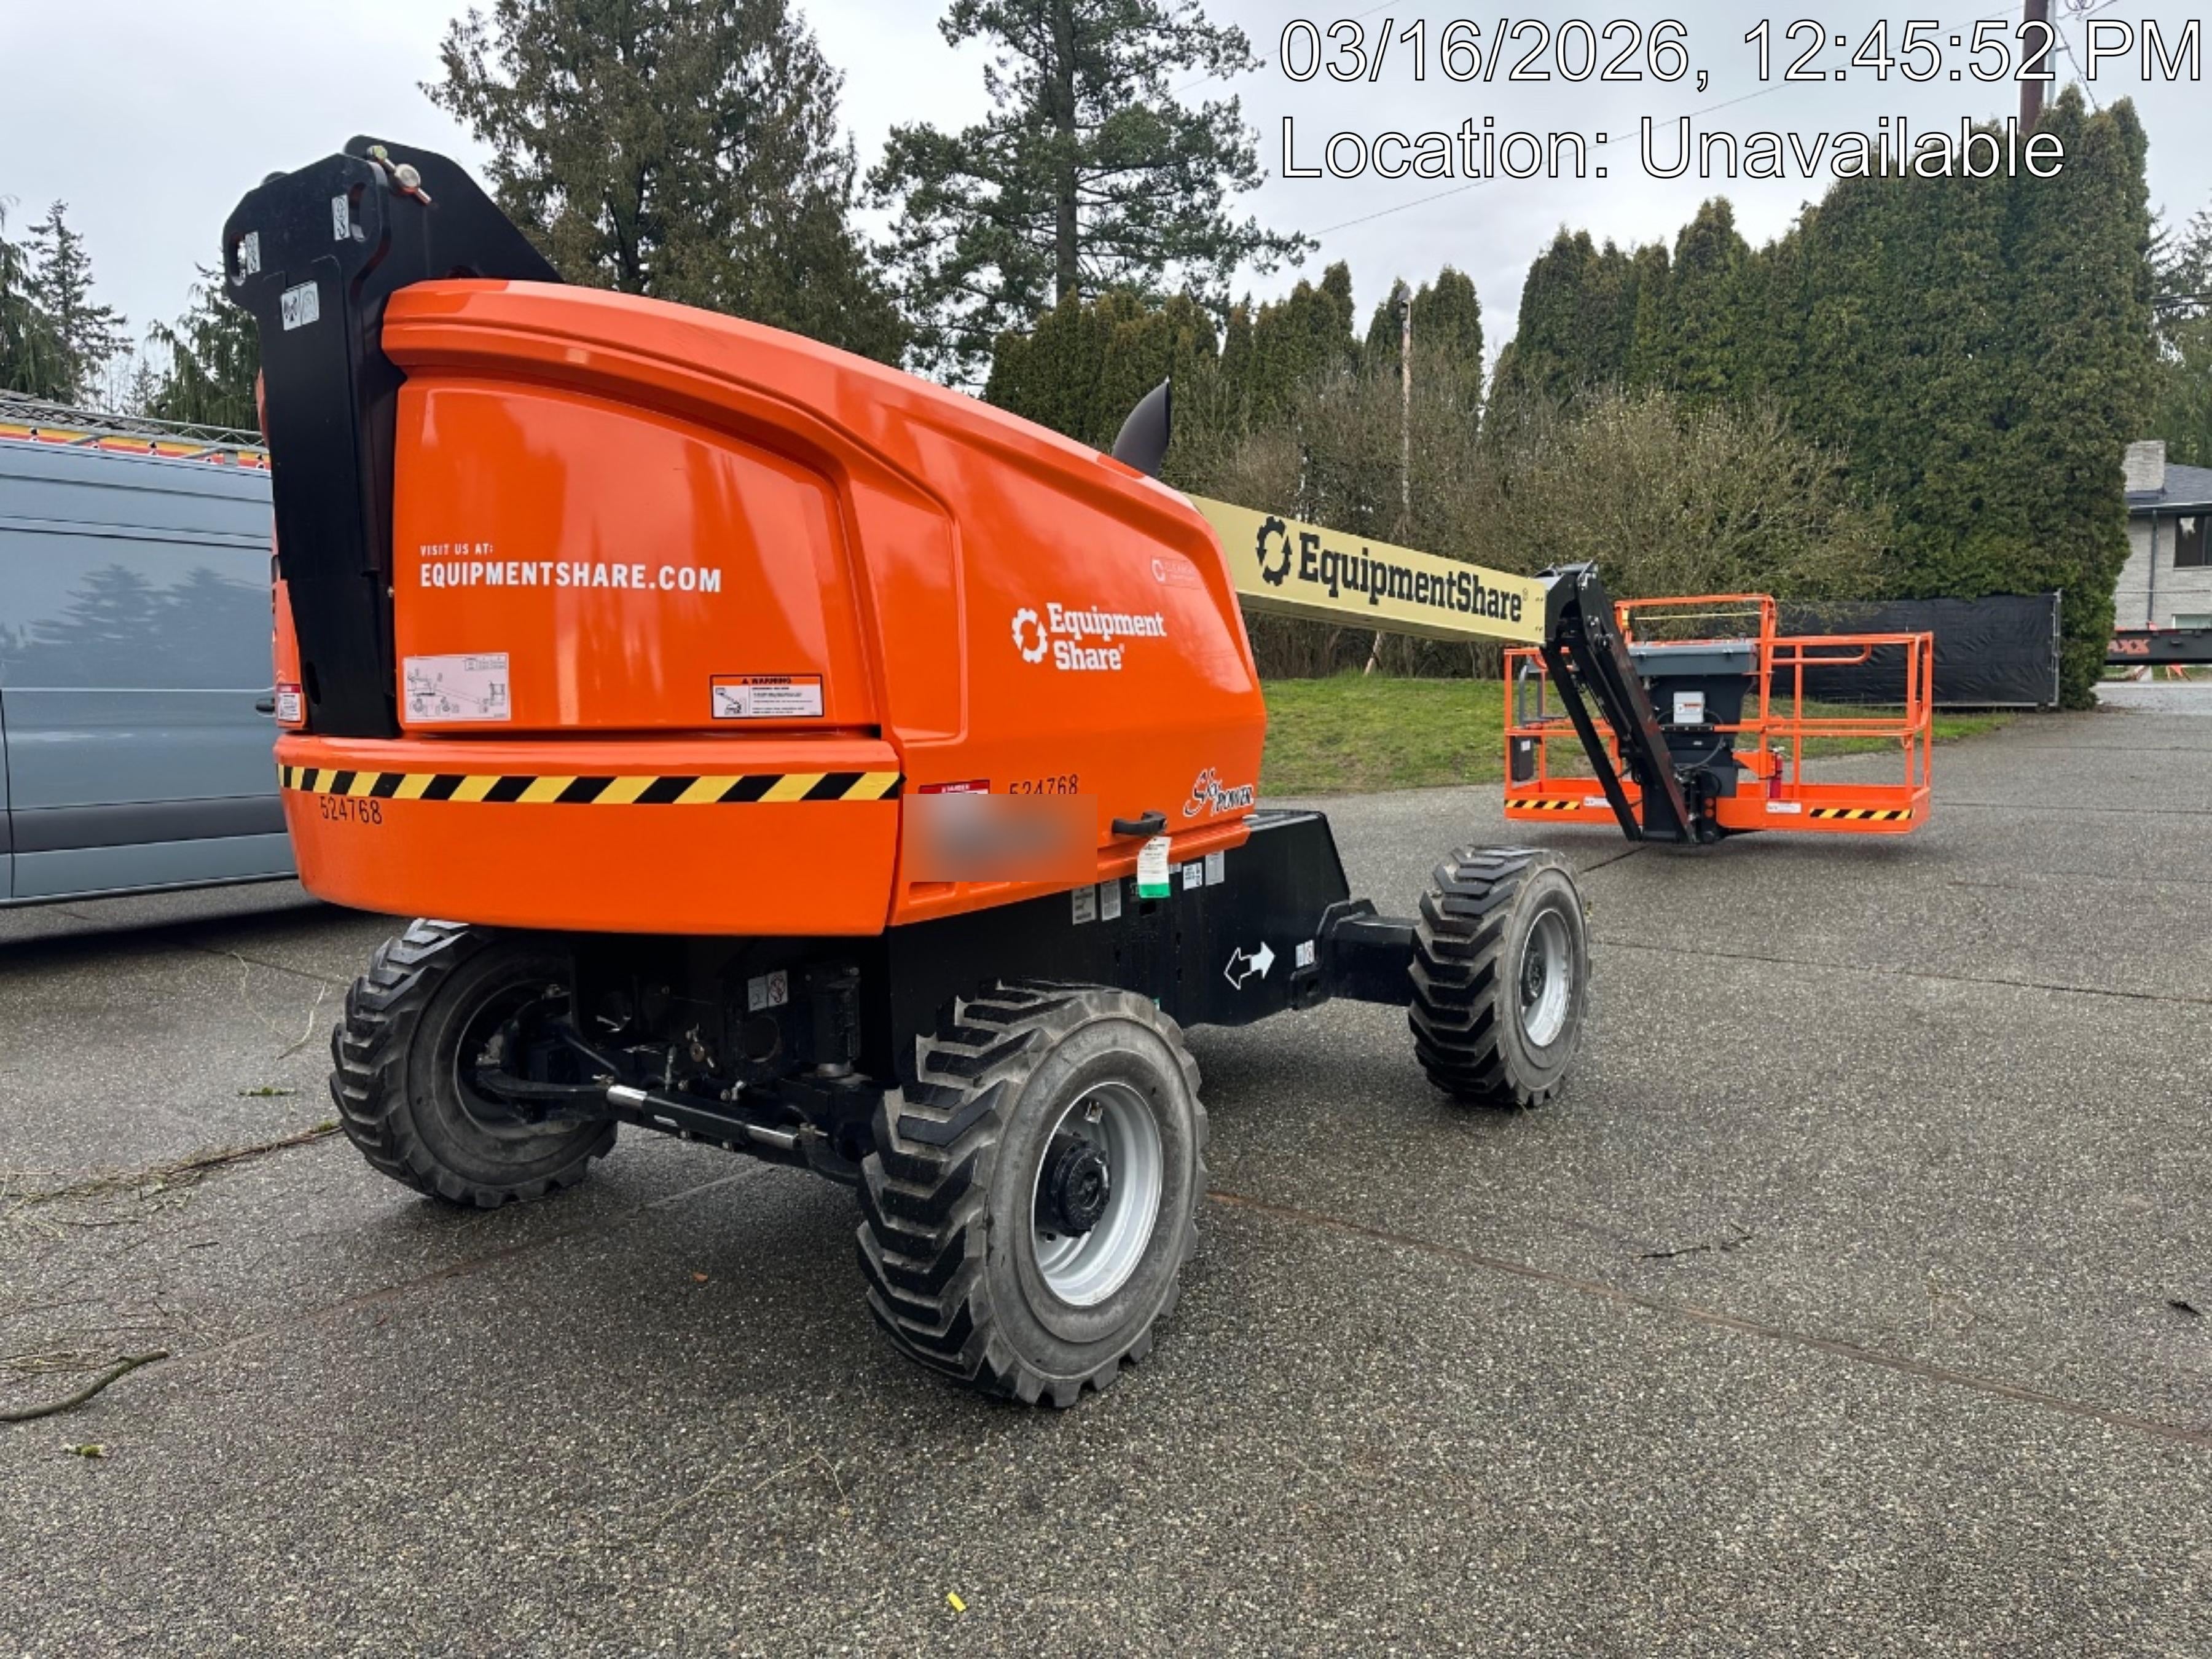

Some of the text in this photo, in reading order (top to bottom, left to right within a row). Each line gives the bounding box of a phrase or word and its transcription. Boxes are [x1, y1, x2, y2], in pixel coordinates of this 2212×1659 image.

[420, 543, 493, 555] VISIT US AT:
[420, 562, 721, 592] EQUIPMENTSHARE.COM
[1046, 602, 1167, 641] Equipment
[319, 796, 382, 825] 524768
